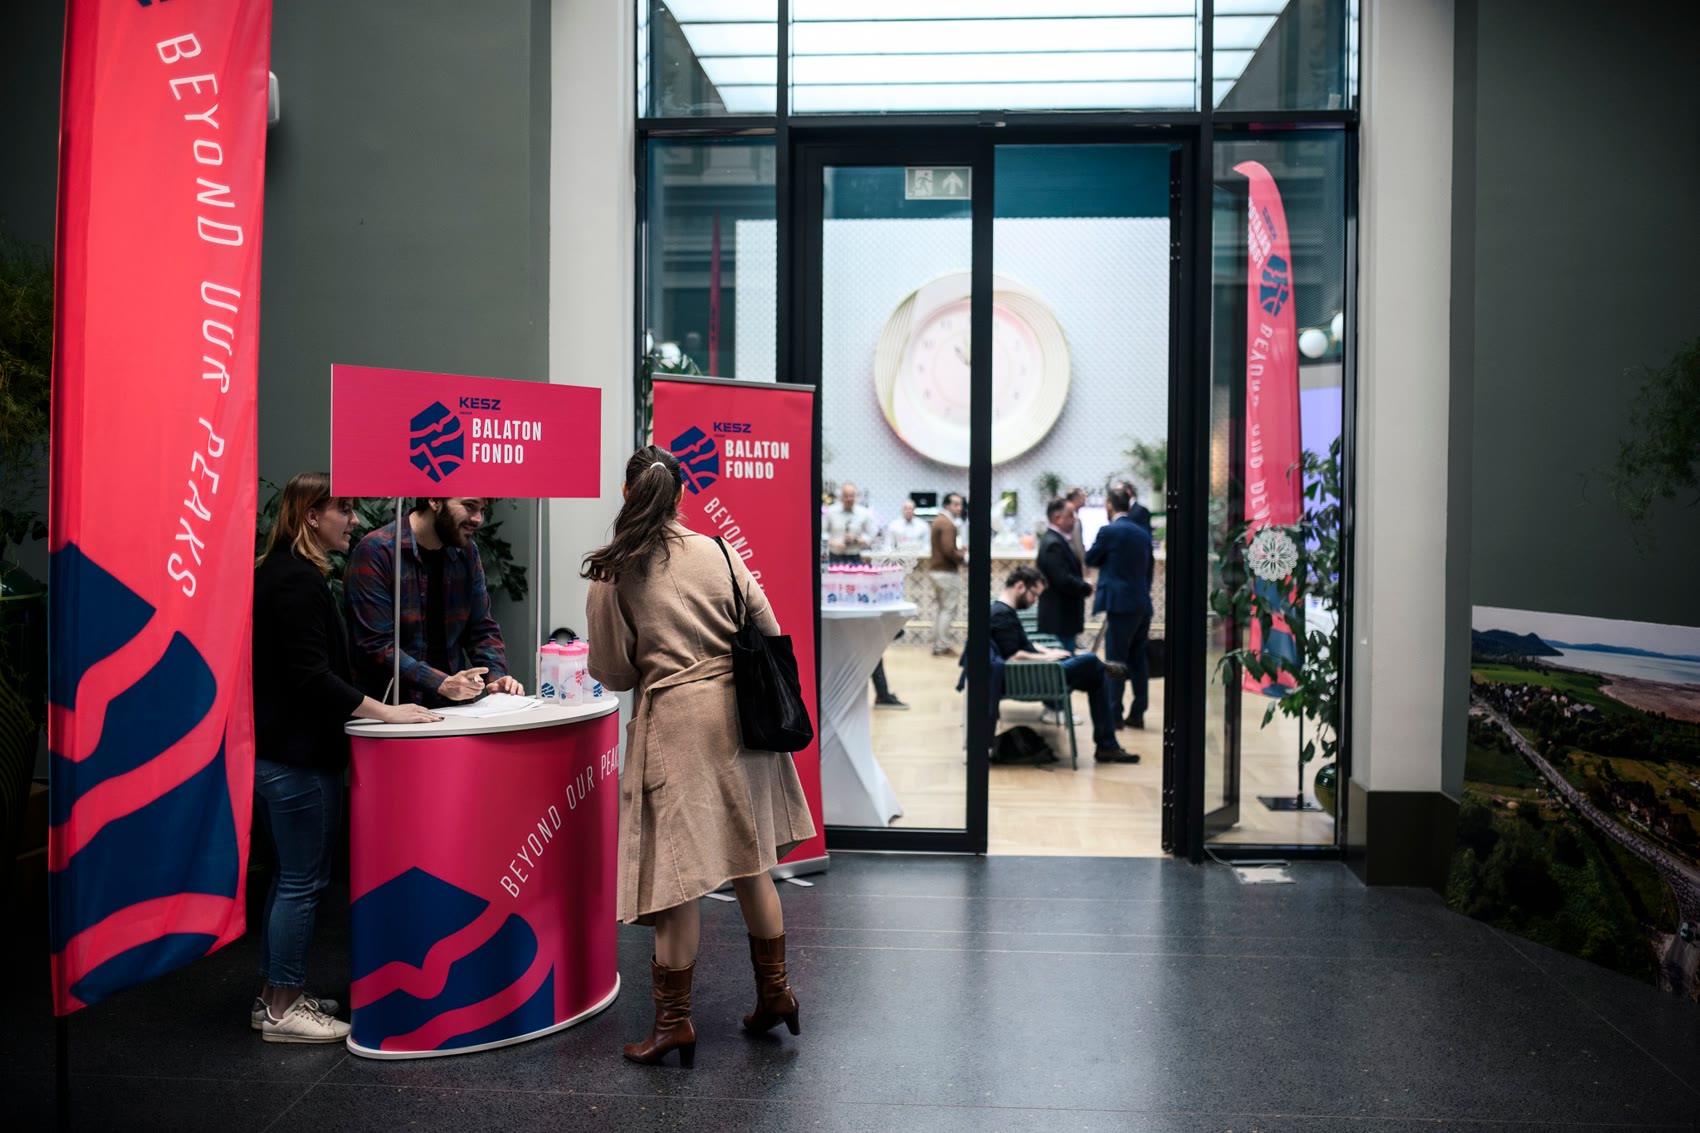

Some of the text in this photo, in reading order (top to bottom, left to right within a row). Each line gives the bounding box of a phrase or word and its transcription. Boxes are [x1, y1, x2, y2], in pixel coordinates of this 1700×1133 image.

[156, 33, 243, 246] BEYOND
[459, 396, 501, 410] KESZ
[472, 417, 542, 441] BALATON
[713, 422, 752, 433] KESZ
[472, 442, 524, 464] FONDO
[725, 439, 790, 459] BALATON
[725, 461, 774, 479] FONDO
[167, 417, 225, 597] PEAKS
[703, 497, 753, 561] BEYOND
[500, 805, 562, 898] BEYOND
[566, 765, 595, 810] OUR
